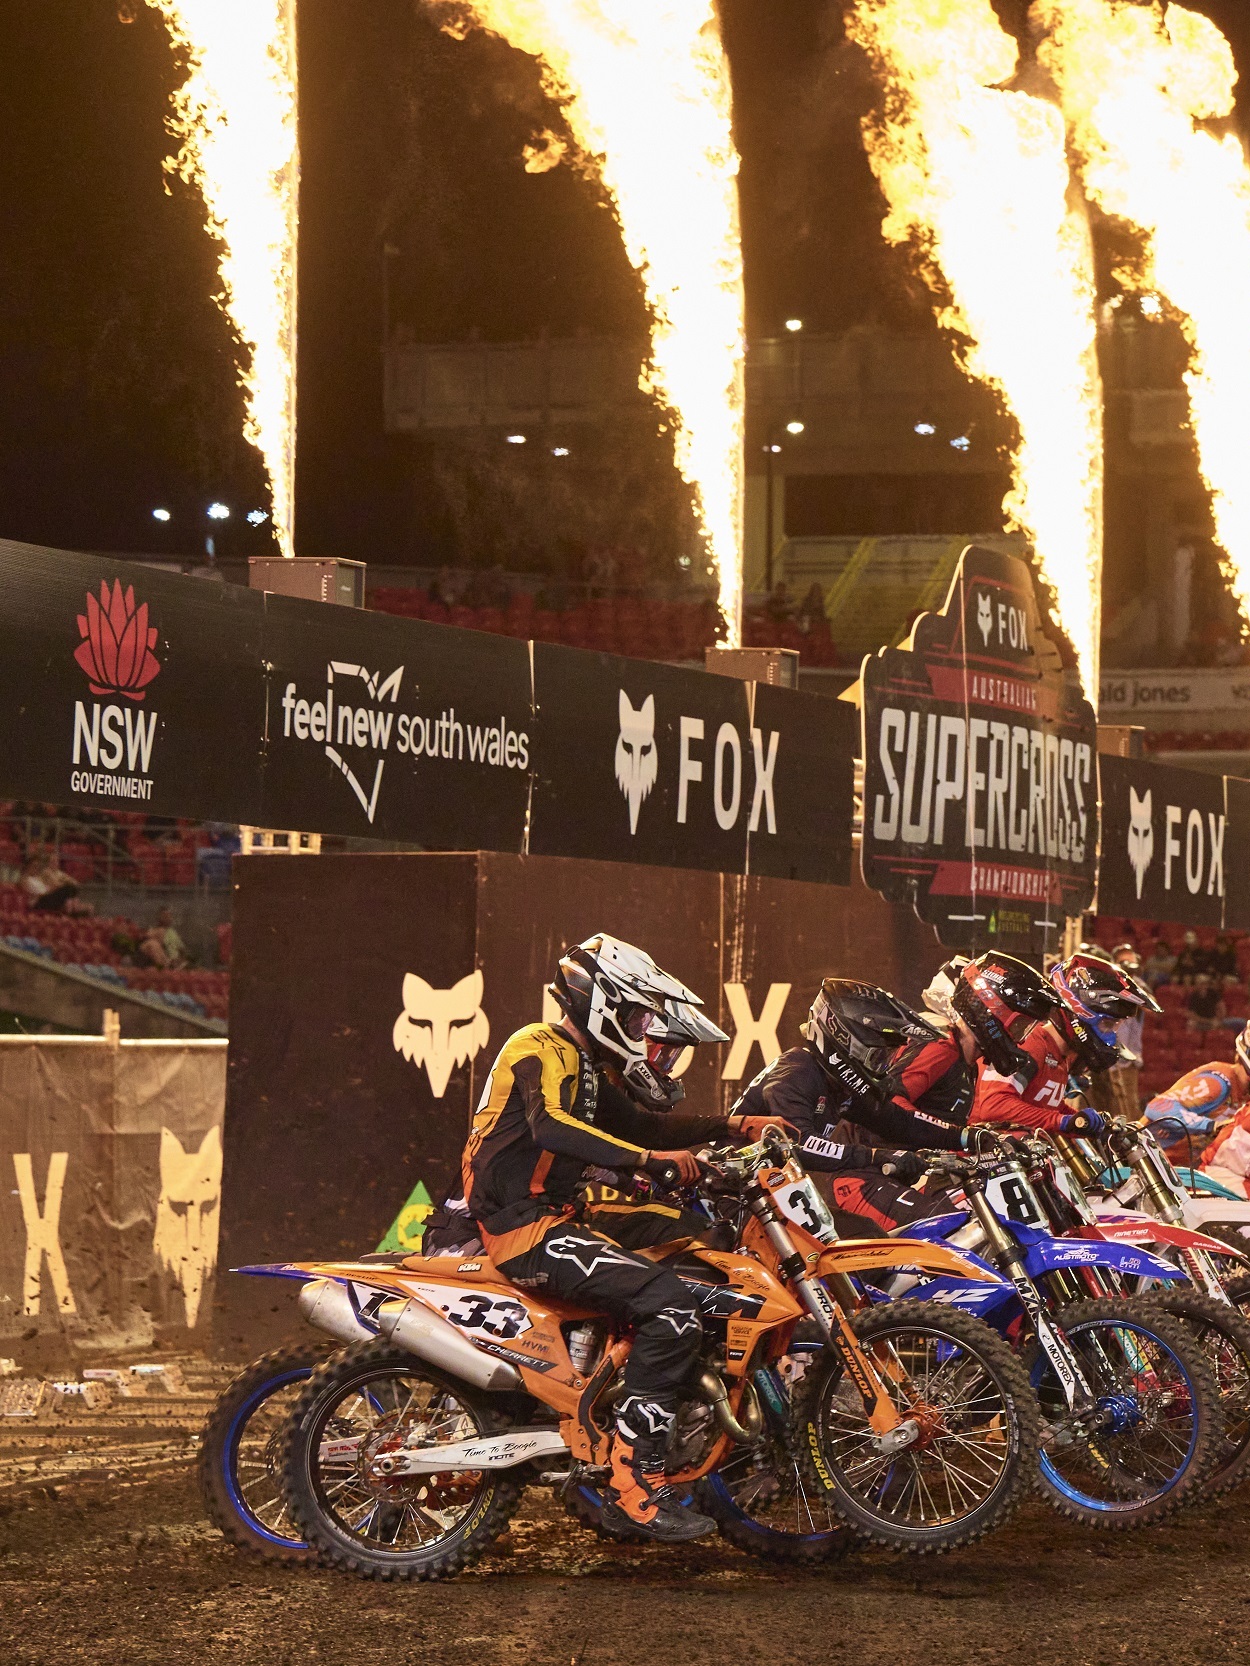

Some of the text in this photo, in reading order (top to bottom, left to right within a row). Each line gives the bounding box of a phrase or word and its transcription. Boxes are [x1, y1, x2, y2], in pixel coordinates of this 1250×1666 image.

[997, 603, 1028, 651] FOX
[1131, 680, 1191, 706] jones
[72, 700, 158, 773] NSW
[282, 682, 530, 771] feel new south wales
[71, 770, 154, 800] GOVERNMENT
[676, 716, 780, 836] FOX
[873, 707, 1091, 864] SUPERCROSS
[1164, 804, 1226, 897] FOX
[1070, 1018, 1088, 1043] froth
[806, 1138, 841, 1157] UNIT
[1000, 1177, 1041, 1223] 8
[459, 1263, 482, 1272] KTM
[447, 1294, 528, 1339] 33
[487, 1343, 549, 1368] CHERRETT
[841, 1347, 873, 1398] DUNLOP
[1047, 1344, 1074, 1386] MOTOREX
[462, 1448, 487, 1457] Time
[502, 1440, 537, 1452] Boogie
[807, 1421, 837, 1491] DUNLOP
